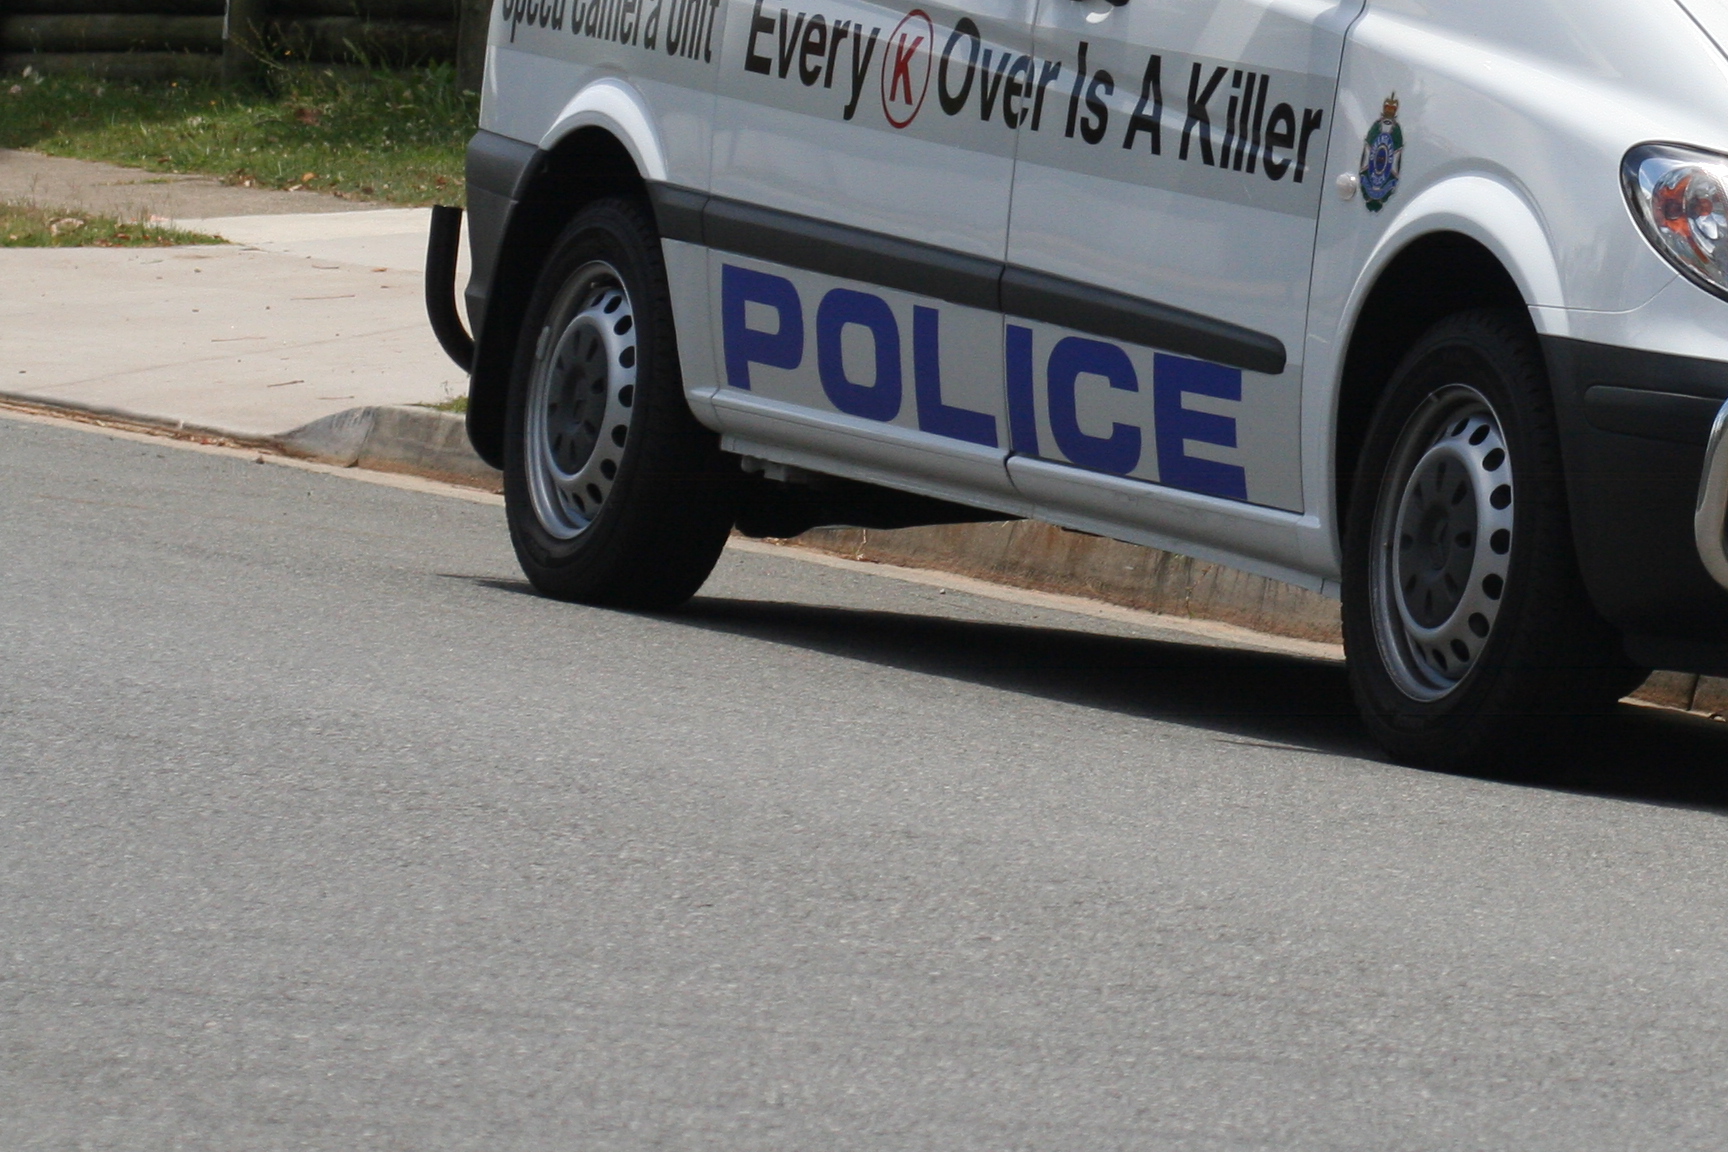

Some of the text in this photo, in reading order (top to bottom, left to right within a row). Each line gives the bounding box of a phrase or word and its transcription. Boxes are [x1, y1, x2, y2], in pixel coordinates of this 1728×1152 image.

[889, 32, 924, 105] K
[938, 17, 1062, 131] Over
[1064, 41, 1114, 145] Is
[1122, 54, 1163, 155] A
[1178, 62, 1323, 184] Killer
[721, 263, 1248, 501] POLICE
